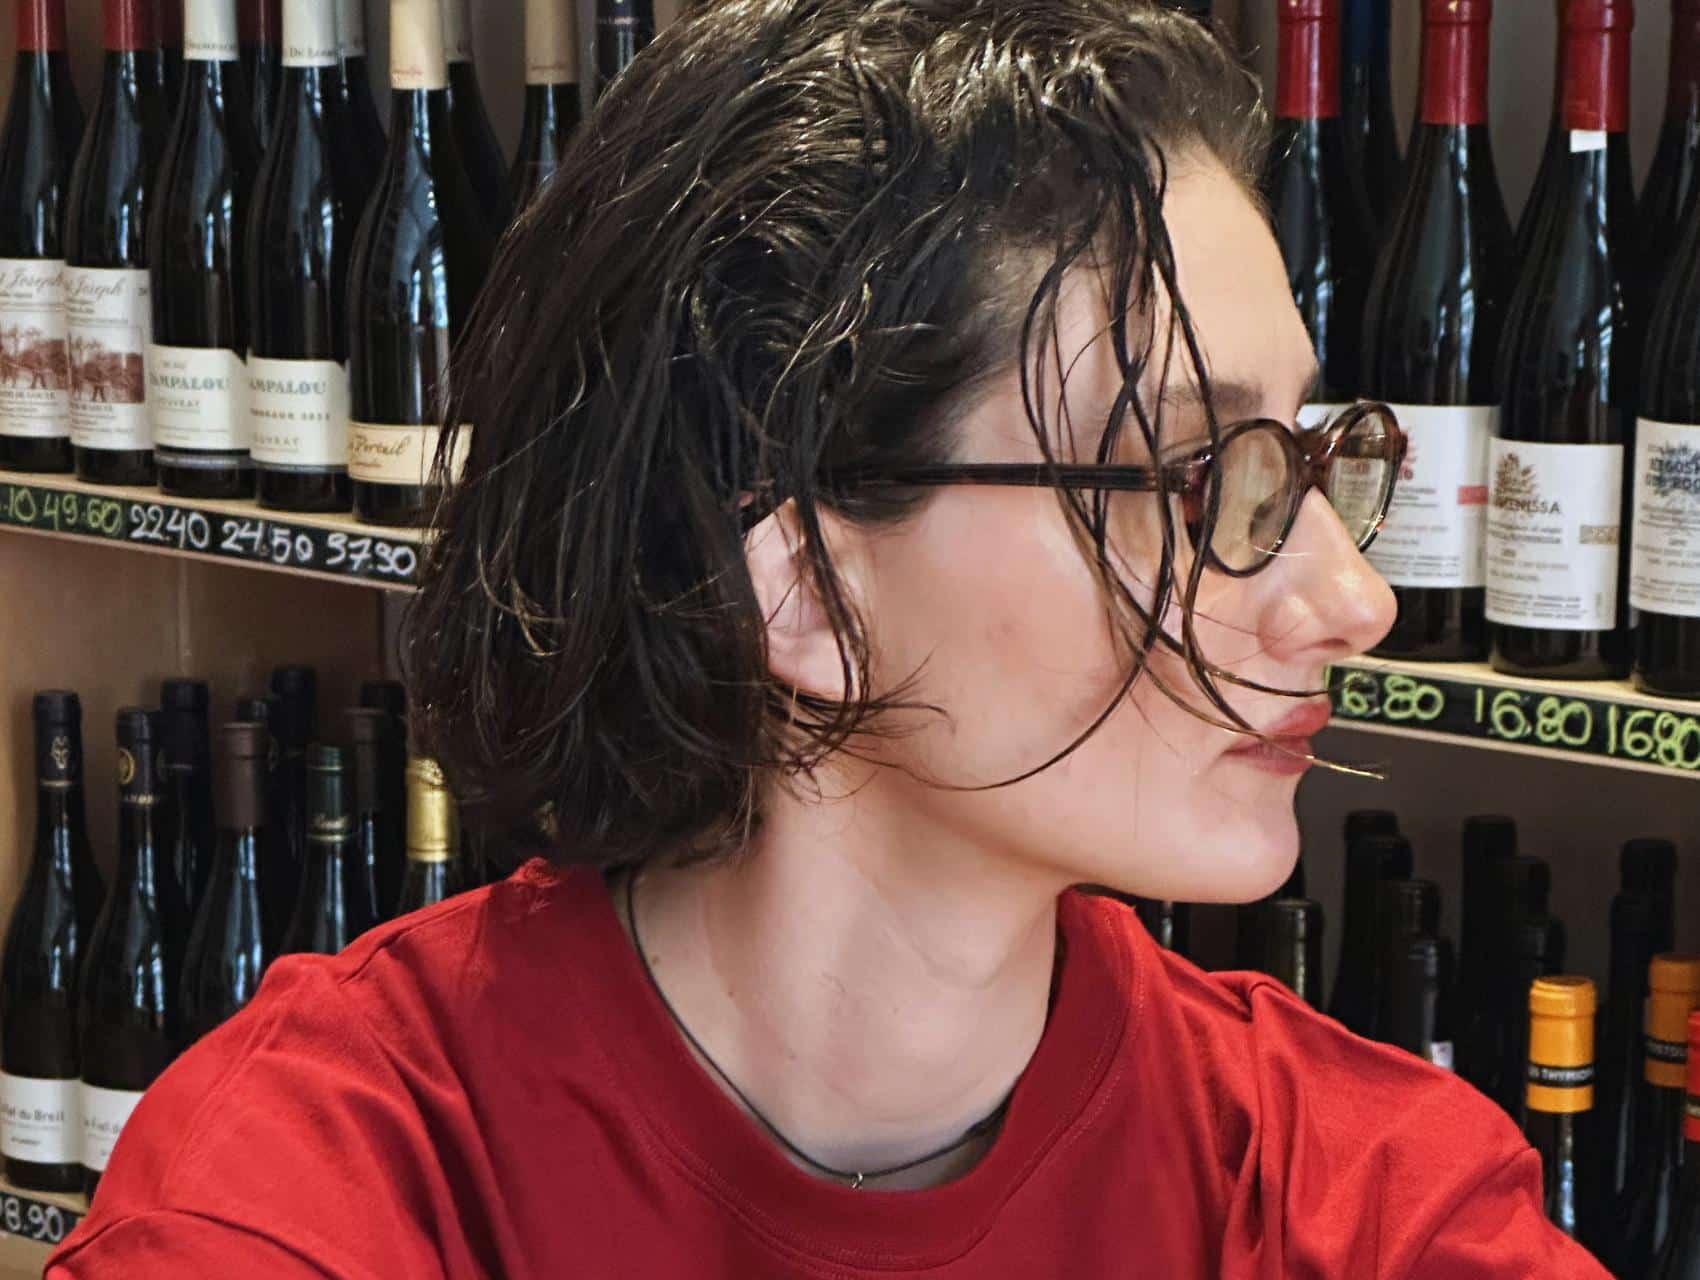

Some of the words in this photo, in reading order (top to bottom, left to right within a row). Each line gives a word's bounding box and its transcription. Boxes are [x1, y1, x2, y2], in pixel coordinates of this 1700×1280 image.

[130, 504, 210, 549] 22.40
[220, 520, 313, 564] 24.50
[1475, 687, 1592, 745] 16.80
[1607, 703, 1700, 769] 16.80
[0, 1196, 63, 1242] 8.90
